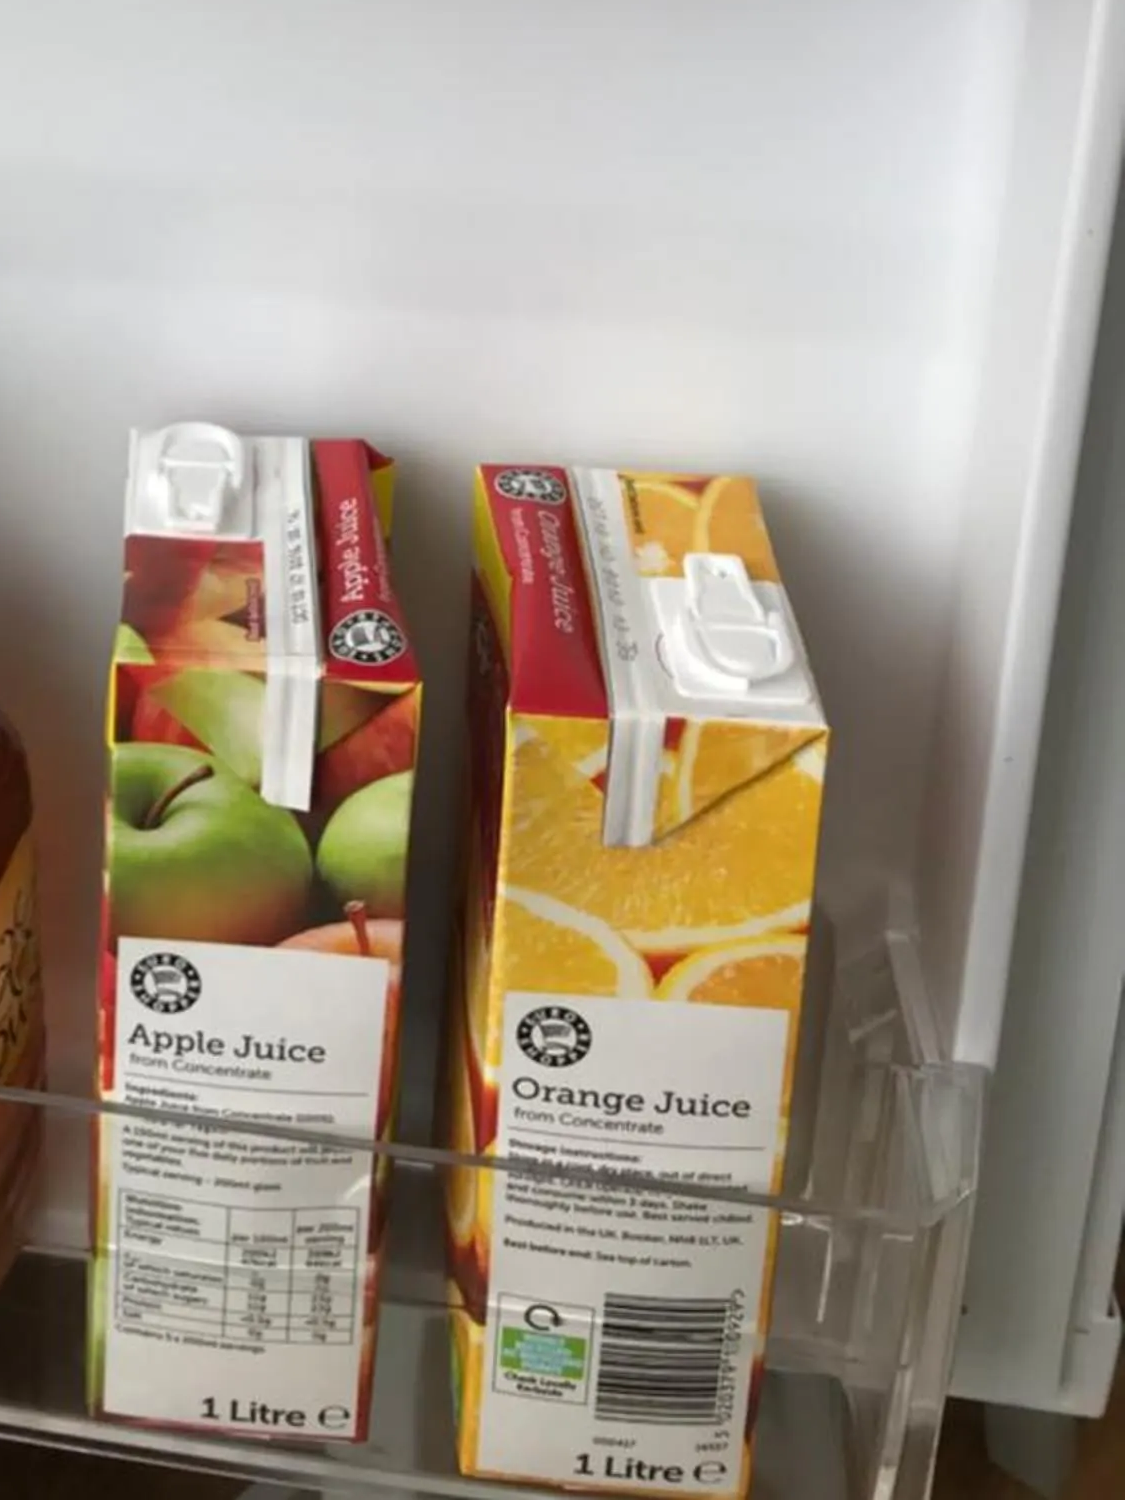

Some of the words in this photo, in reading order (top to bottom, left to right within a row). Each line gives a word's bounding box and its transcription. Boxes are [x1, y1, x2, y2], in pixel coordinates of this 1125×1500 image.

[335, 497, 359, 546] Juice
[537, 510, 566, 575] Orange
[337, 546, 369, 603] Apple
[550, 574, 575, 633] Juice
[128, 1022, 225, 1057] Apple
[233, 1034, 326, 1063] Juice
[129, 1052, 168, 1070] from
[172, 1059, 272, 1080] Concentrate
[512, 1076, 645, 1115] Orange
[654, 1091, 751, 1119] Juice
[513, 1107, 555, 1124] from
[559, 1112, 664, 1135] Concentrate
[201, 1396, 219, 1419] 1
[230, 1398, 306, 1427] Litre
[574, 1452, 594, 1476] 1
[605, 1455, 684, 1483] Litre
